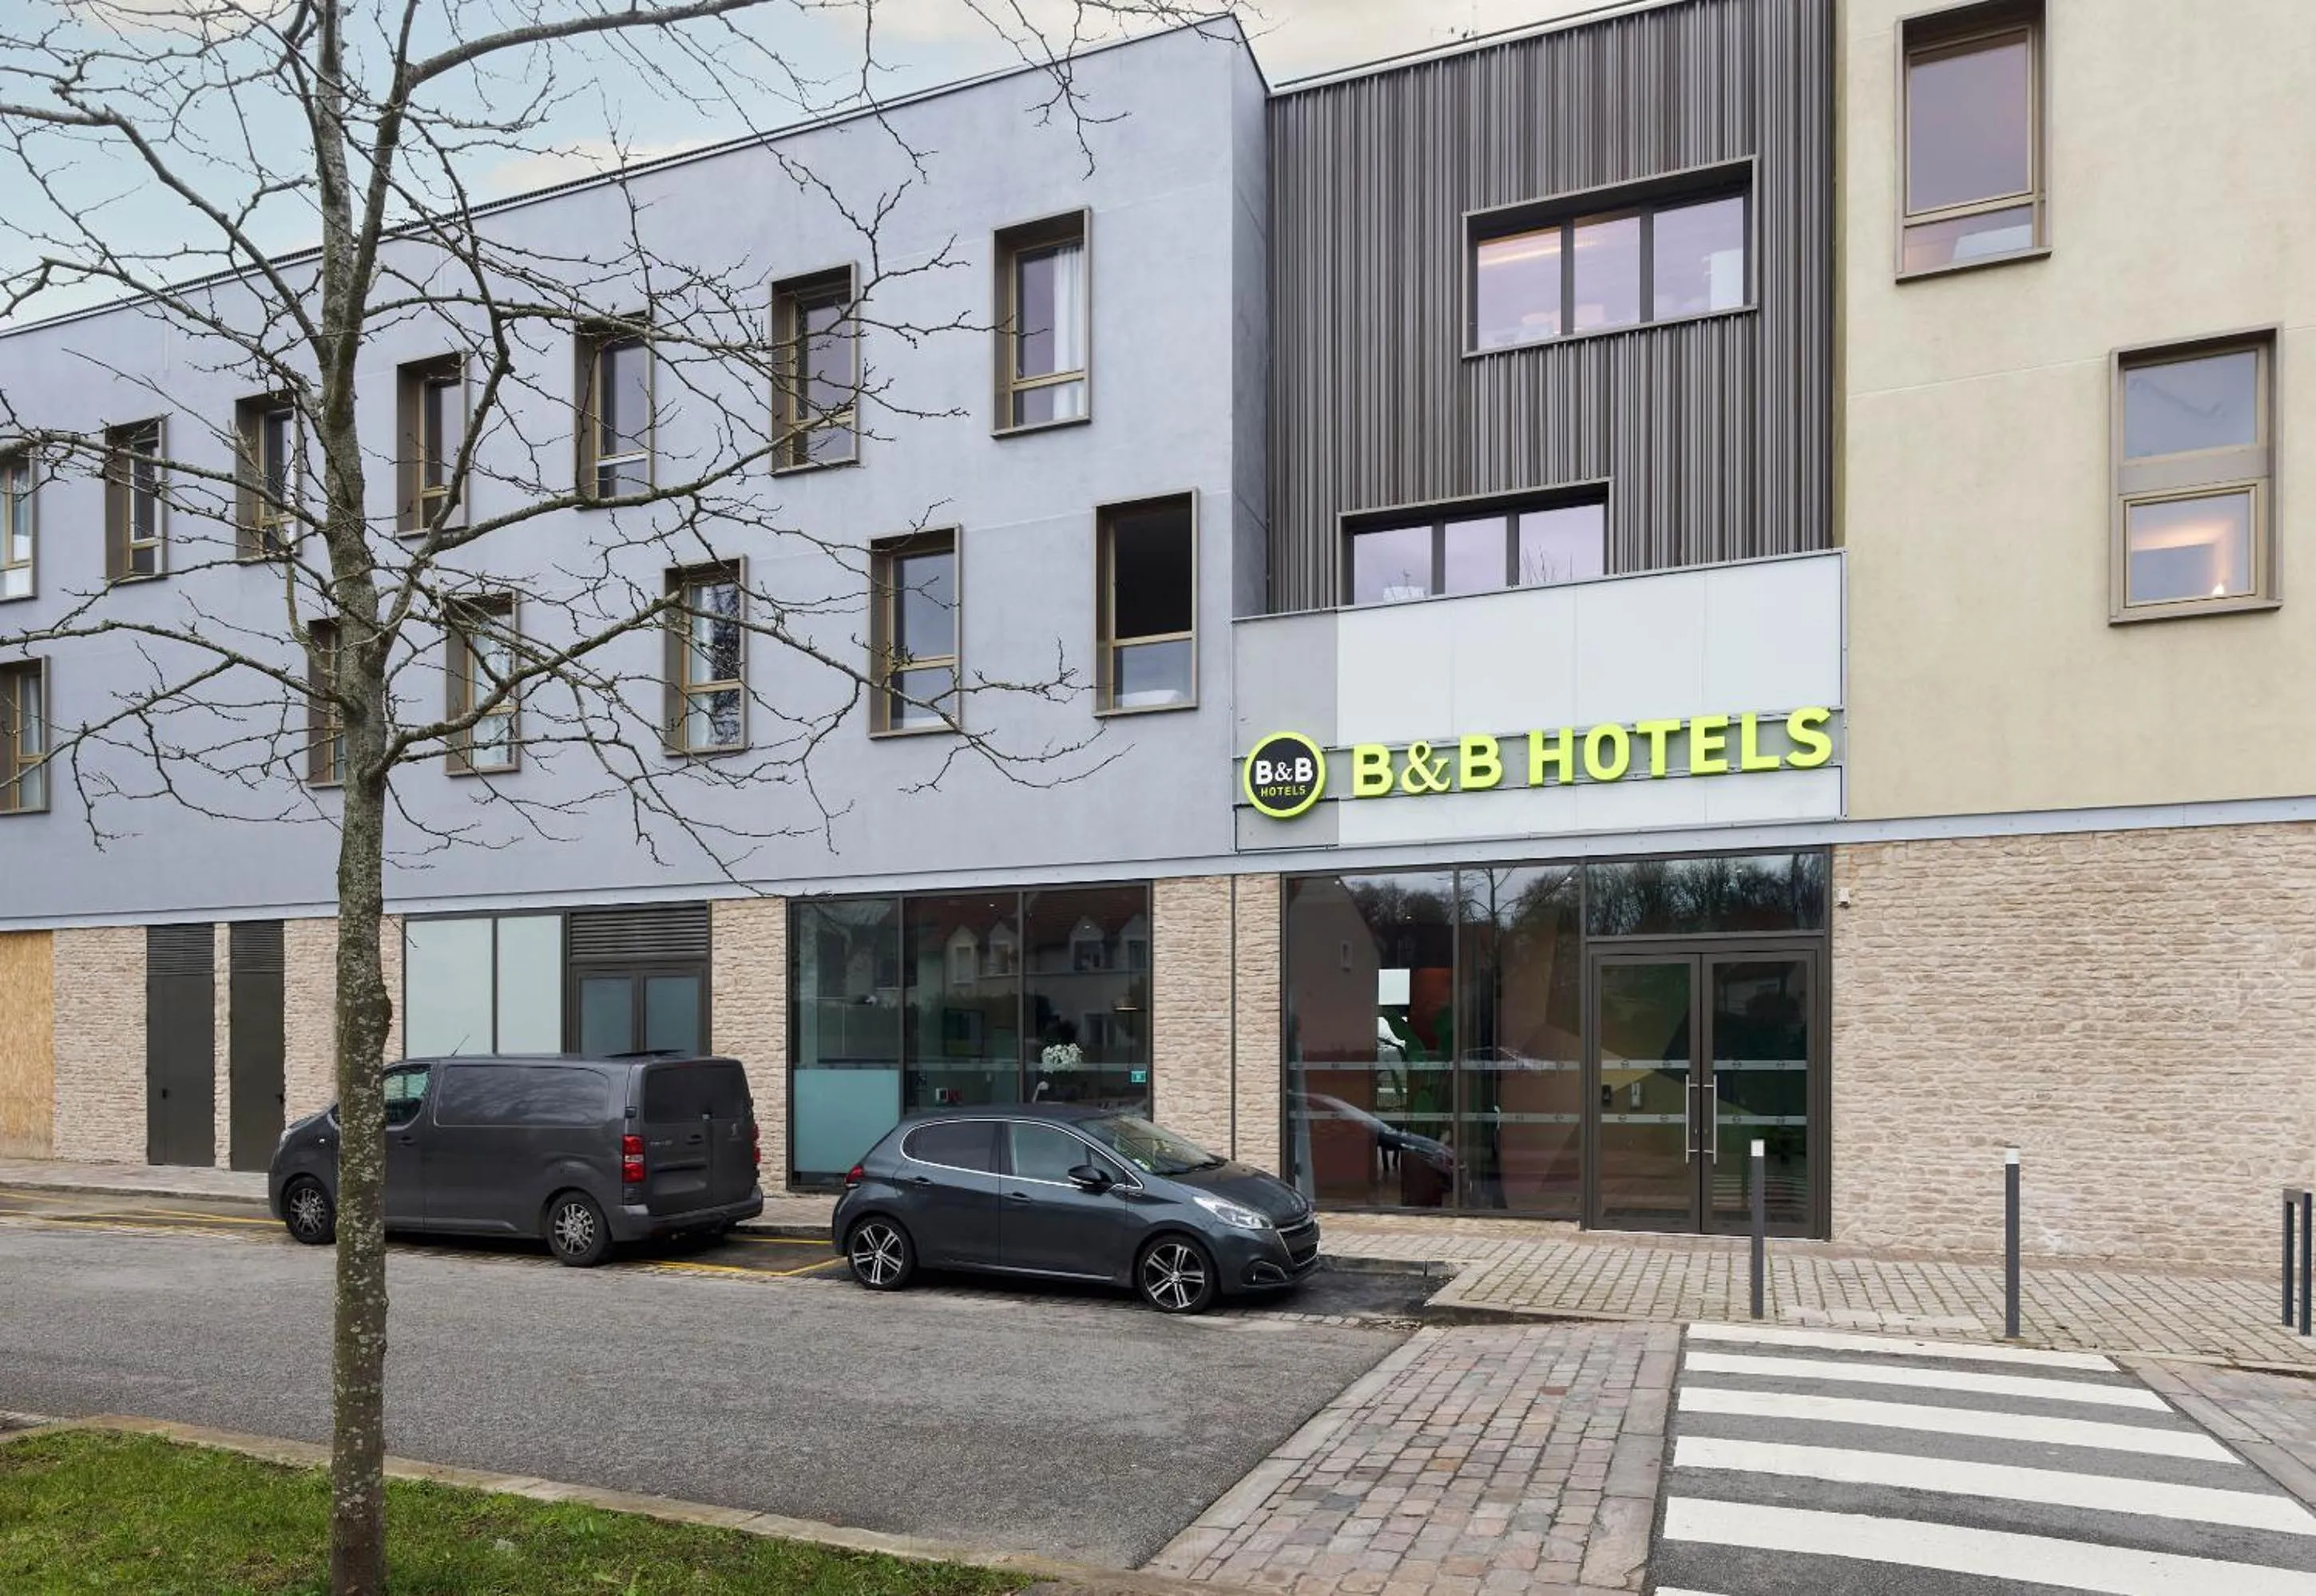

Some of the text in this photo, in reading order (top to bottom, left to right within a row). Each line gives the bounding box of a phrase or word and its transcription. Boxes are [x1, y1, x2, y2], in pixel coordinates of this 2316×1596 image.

[1353, 706, 1833, 797] B&B HOTELS
[1255, 757, 1314, 785] B&B
[1260, 785, 1306, 797] HOTELS
